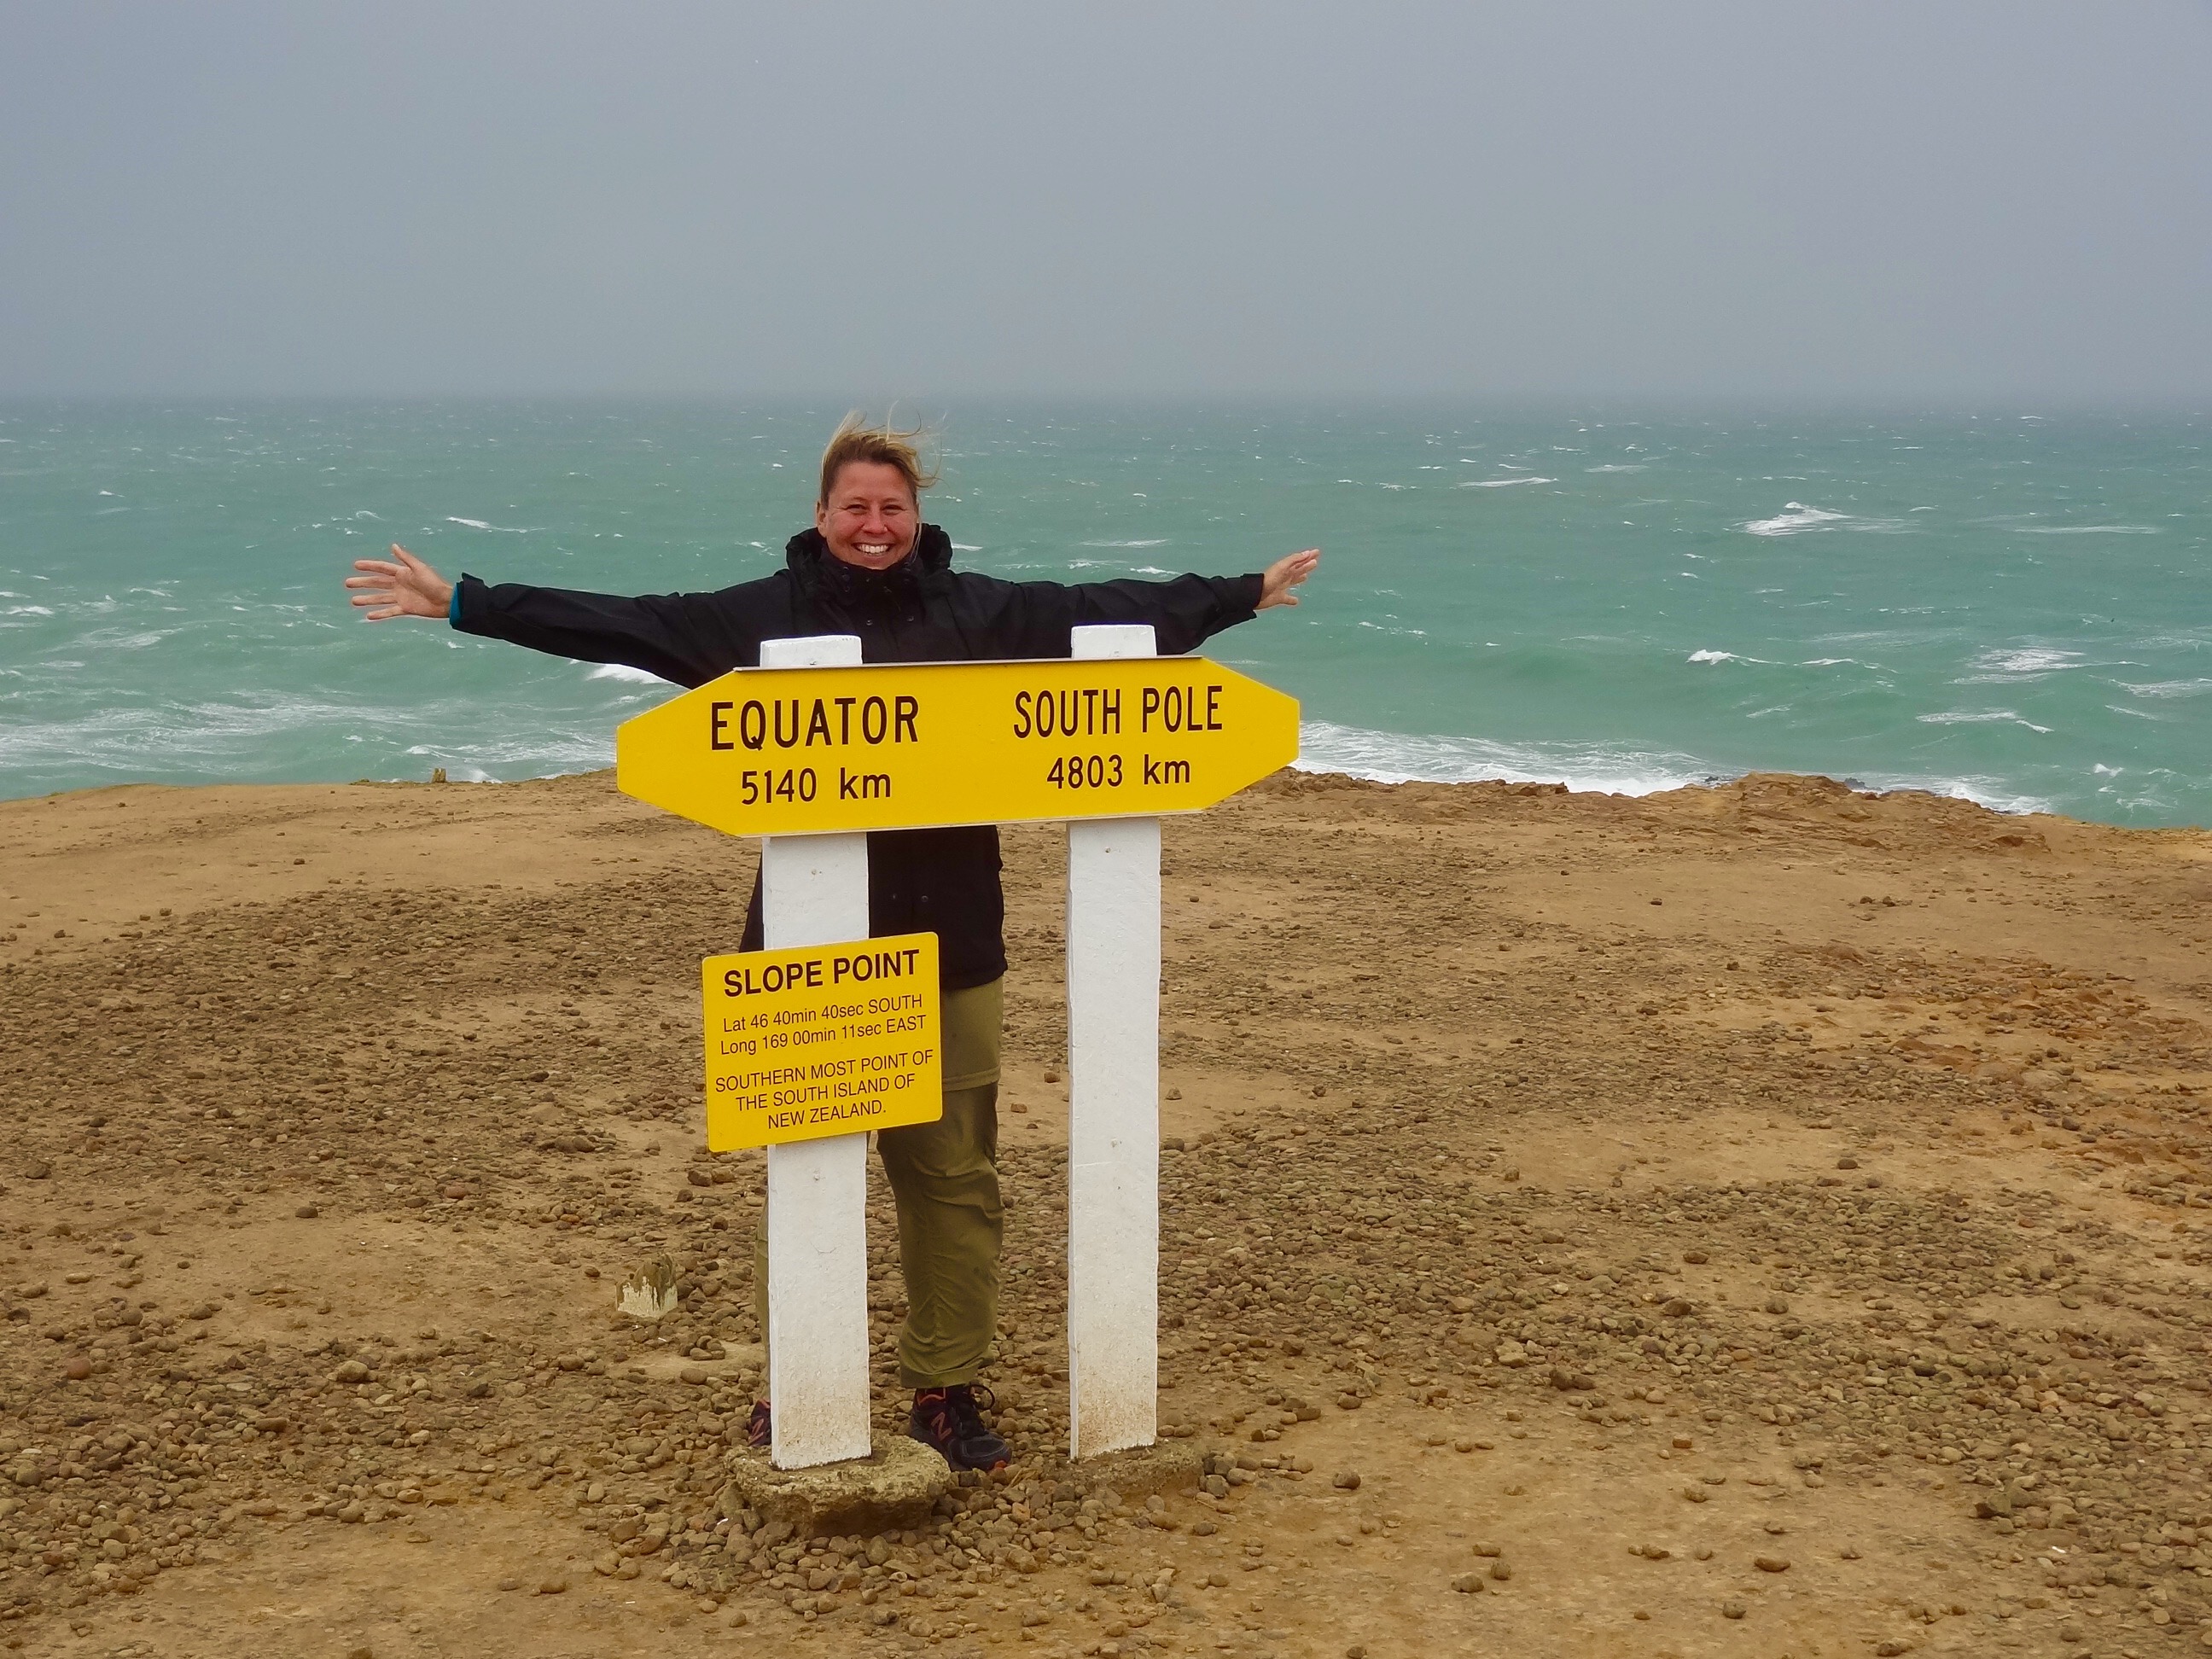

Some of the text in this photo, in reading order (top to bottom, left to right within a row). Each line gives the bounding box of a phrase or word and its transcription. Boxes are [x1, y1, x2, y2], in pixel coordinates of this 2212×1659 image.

[711, 696, 919, 752] EQUATOR
[1013, 685, 1223, 739] SOUTH POLE
[742, 766, 891, 806] 5140 km
[1046, 754, 1190, 789] 4803 km
[724, 948, 920, 998] SLOPE POINT
[723, 993, 923, 1033] Lat 46 40min 40sec SOUTH
[720, 1014, 927, 1056] Long 169 00min 11sec EAST
[715, 1049, 934, 1093] SOUTHERN MOST POINT OF
[735, 1073, 916, 1112] THE SOUTH ISLAND OF
[768, 1099, 887, 1130] NEW ZEALAND.
